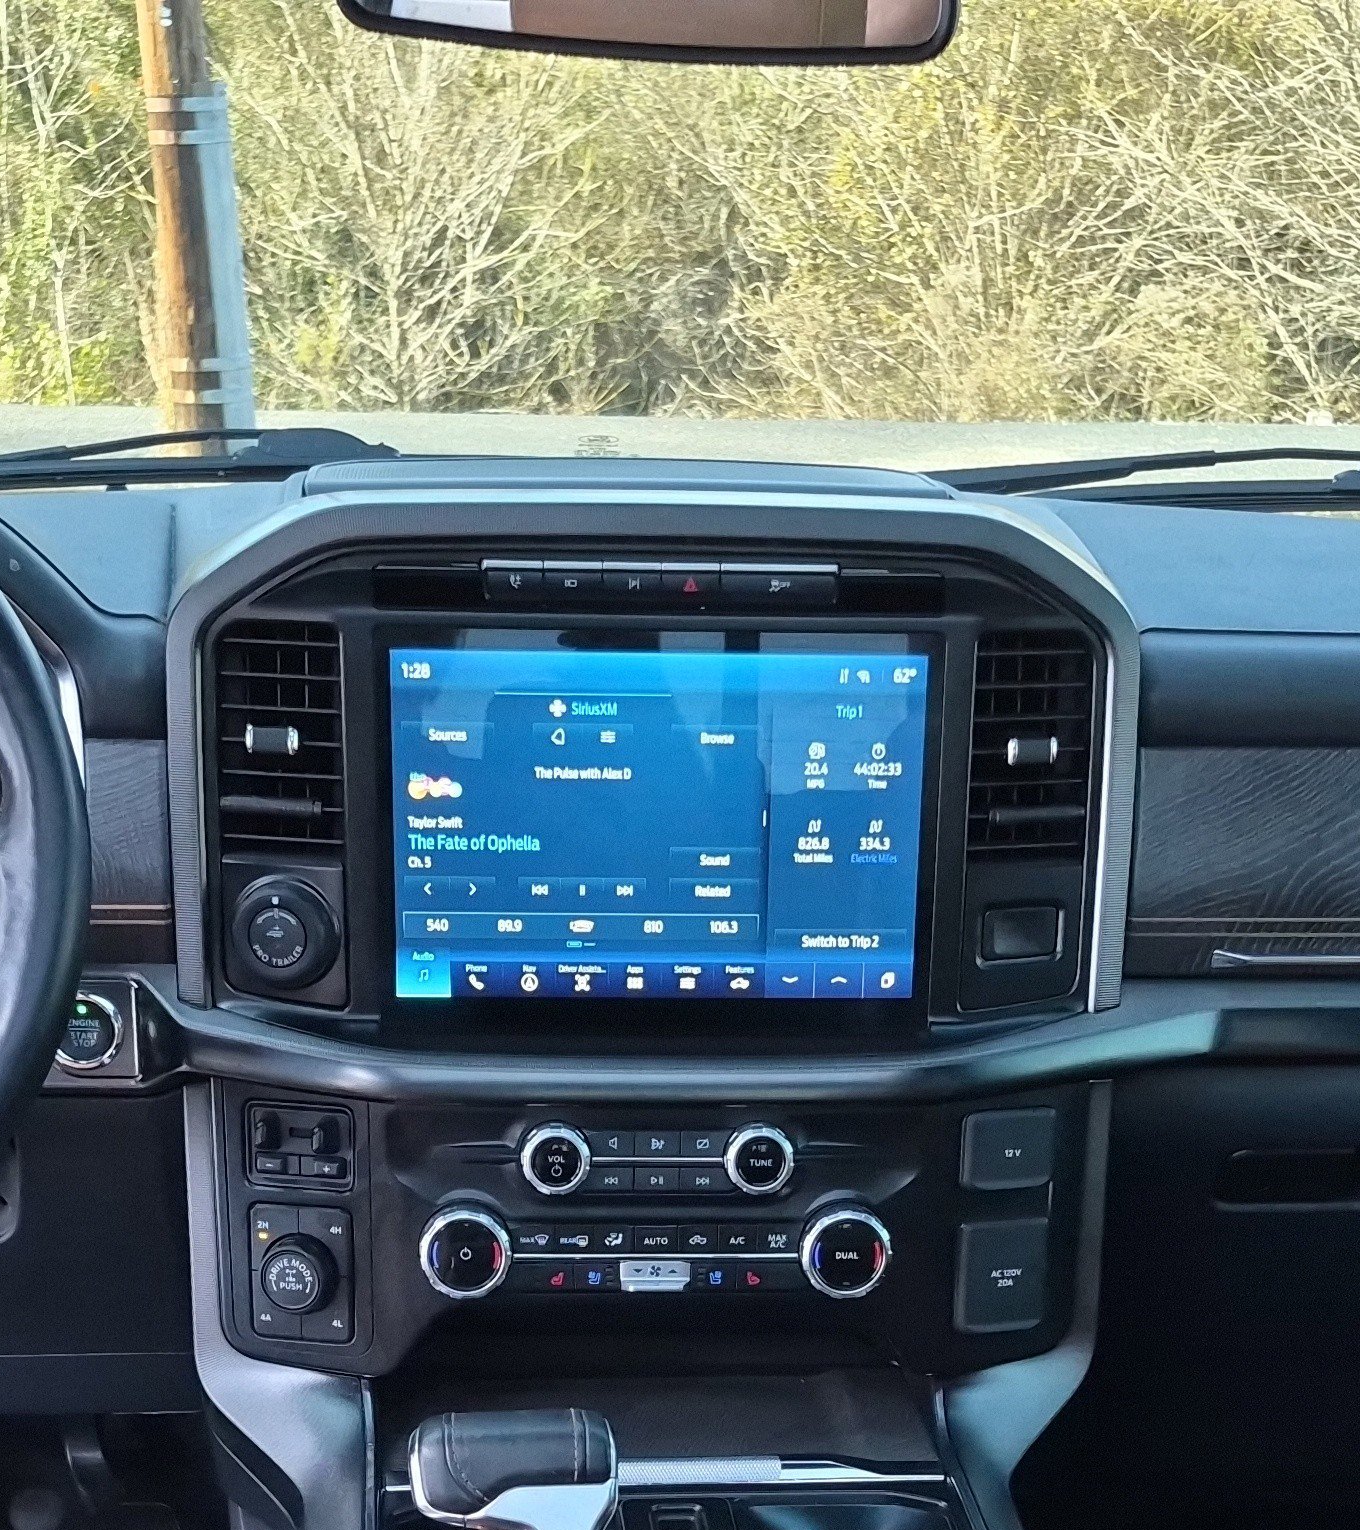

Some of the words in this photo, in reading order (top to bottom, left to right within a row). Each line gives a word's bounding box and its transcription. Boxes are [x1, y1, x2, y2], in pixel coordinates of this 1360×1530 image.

[401, 662, 431, 679] 1:28
[571, 701, 618, 716] SiriusXM
[836, 705, 857, 720] Trip
[858, 704, 863, 718] 1
[428, 728, 467, 742] Sources
[700, 732, 735, 745] Browse
[534, 766, 552, 779] The
[553, 767, 579, 779] Pulse
[580, 767, 601, 779] with
[602, 768, 622, 780] Alex
[623, 768, 632, 780] D
[804, 762, 829, 776] 20.4
[853, 762, 902, 776] 44:02:33
[407, 816, 437, 830] Taylor
[438, 816, 463, 829] Swift
[408, 834, 435, 850] The
[438, 834, 468, 850] Fate
[471, 835, 486, 850] of
[488, 835, 540, 853] Ophelia
[859, 837, 890, 851] 334.3
[407, 856, 423, 868] Ch.
[424, 857, 432, 868] 5
[699, 854, 730, 867] Sound
[793, 853, 813, 863] Total
[814, 853, 833, 863] Miles
[850, 854, 877, 864] Electric
[879, 854, 897, 864] Miles
[695, 885, 731, 897] Related
[426, 918, 449, 932] 540
[497, 919, 523, 932] 89.9
[643, 920, 664, 934] 810
[709, 920, 739, 934] 106.3
[801, 935, 836, 948] Switch
[837, 936, 850, 948] to
[850, 935, 871, 949] Trip
[872, 935, 880, 948] 2
[253, 944, 270, 962] PRO
[272, 945, 304, 966] TRAILER
[412, 951, 435, 961] Audio
[465, 964, 488, 973] Phone
[522, 964, 537, 973] Nav
[558, 965, 578, 973] Driver
[626, 965, 644, 974] Apps
[674, 965, 702, 975] Settings
[725, 965, 755, 974] Features
[68, 1018, 101, 1027] ENGINE
[70, 1031, 98, 1040] START
[73, 1039, 97, 1047] STOP
[1014, 1149, 1022, 1157] V
[548, 1155, 565, 1163] VOL
[750, 1158, 773, 1167] TUNE
[257, 1220, 269, 1229] 2H
[329, 1226, 342, 1235] 4H
[644, 1237, 668, 1245] AUTO
[729, 1236, 746, 1245] A/C
[768, 1234, 787, 1242] MAX
[770, 1241, 786, 1249] A/C
[835, 1252, 859, 1260] DUAL
[269, 1259, 290, 1281] DRIVE
[291, 1259, 313, 1282] MODE
[991, 1269, 1002, 1278] AC
[1003, 1268, 1022, 1277] 120V
[280, 1281, 302, 1290] PUSH
[997, 1279, 1013, 1287] 20A
[260, 1313, 272, 1322] 4A
[331, 1319, 343, 1328] 4L
